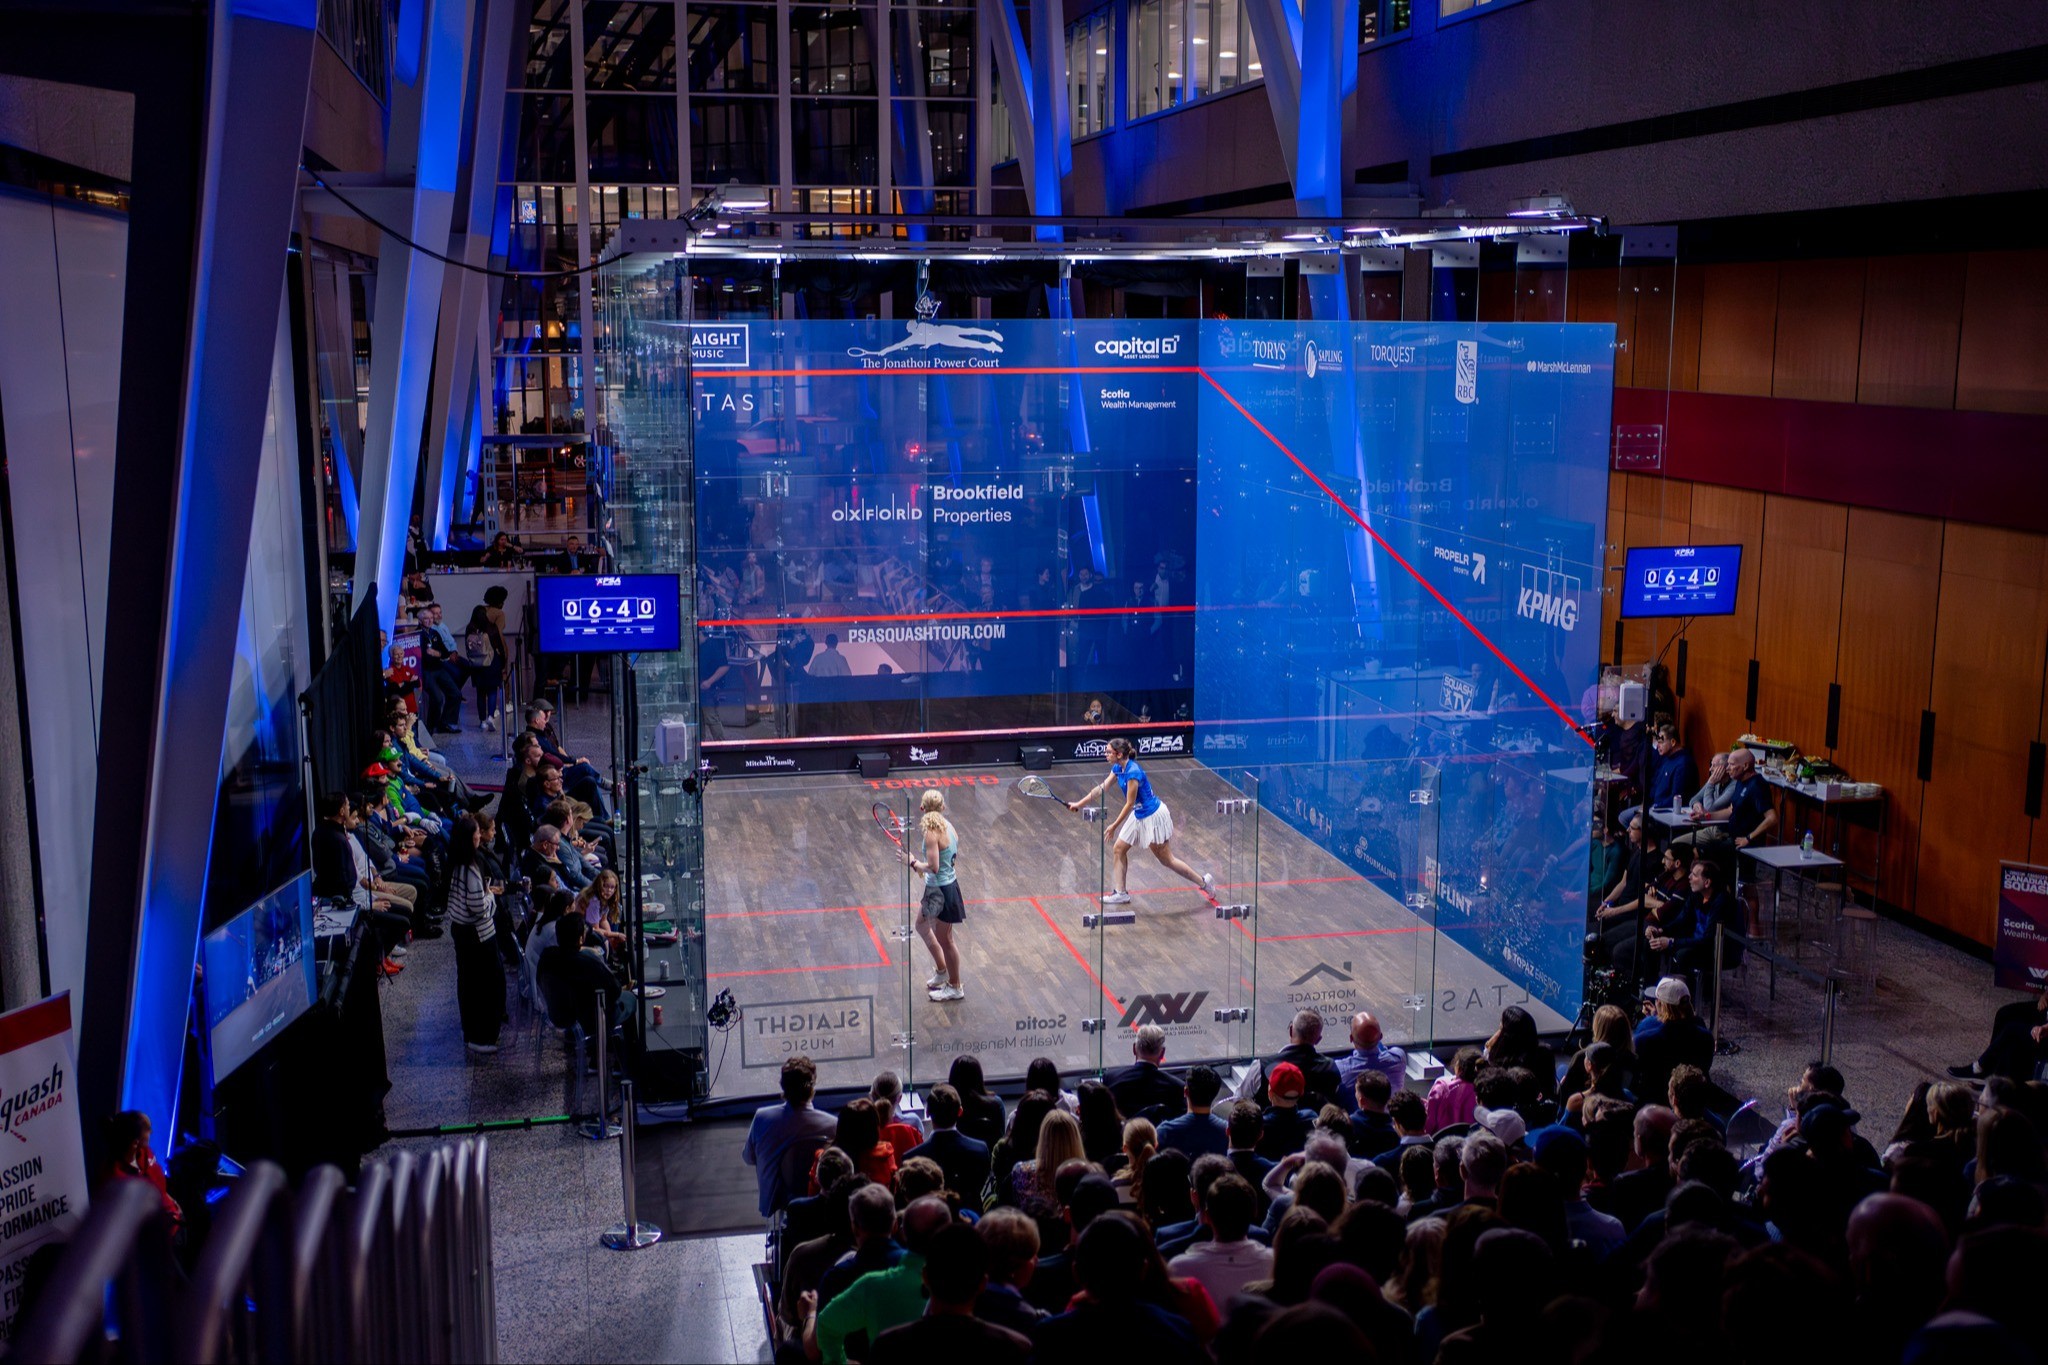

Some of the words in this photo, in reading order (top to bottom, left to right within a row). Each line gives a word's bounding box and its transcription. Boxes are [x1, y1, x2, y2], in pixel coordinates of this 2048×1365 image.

[692, 332, 741, 346] AIGHT
[1094, 336, 1160, 357] capital
[1253, 340, 1286, 361] TORYS
[1318, 349, 1343, 363] SAPLING
[1370, 344, 1416, 368] TORQUEST
[861, 358, 881, 368] The
[883, 358, 931, 370] Jonathon
[934, 358, 966, 368] Power
[968, 357, 1000, 368] Court
[1537, 360, 1592, 374] MarshMcLennan
[1101, 389, 1130, 399] Scotia
[1457, 385, 1475, 399] RBC
[1101, 401, 1127, 409] Wealth
[1128, 401, 1177, 410] Management
[933, 485, 1024, 500] Brookfield
[933, 508, 1012, 526] Properties
[1434, 546, 1470, 566] PROPELR
[1647, 570, 1657, 584] 0
[1707, 568, 1717, 582] 0
[566, 601, 578, 616] 0
[640, 600, 652, 614] 0
[1516, 587, 1577, 632] KPMG
[848, 624, 1006, 644] PSASQUASHTOUR.COM
[1443, 675, 1473, 698] SQUASH
[1453, 690, 1472, 713] TV
[1151, 735, 1185, 747] PSA
[773, 758, 795, 767] Family
[863, 775, 999, 790] TORONTO
[1363, 853, 1397, 881] TOURMALINE
[1441, 881, 1473, 917] FLINT
[2004, 918, 2035, 931] Scotia
[2004, 928, 2031, 940] Wealth
[1513, 952, 1535, 978] TOPAZ
[15, 1092, 62, 1127] CANADA
